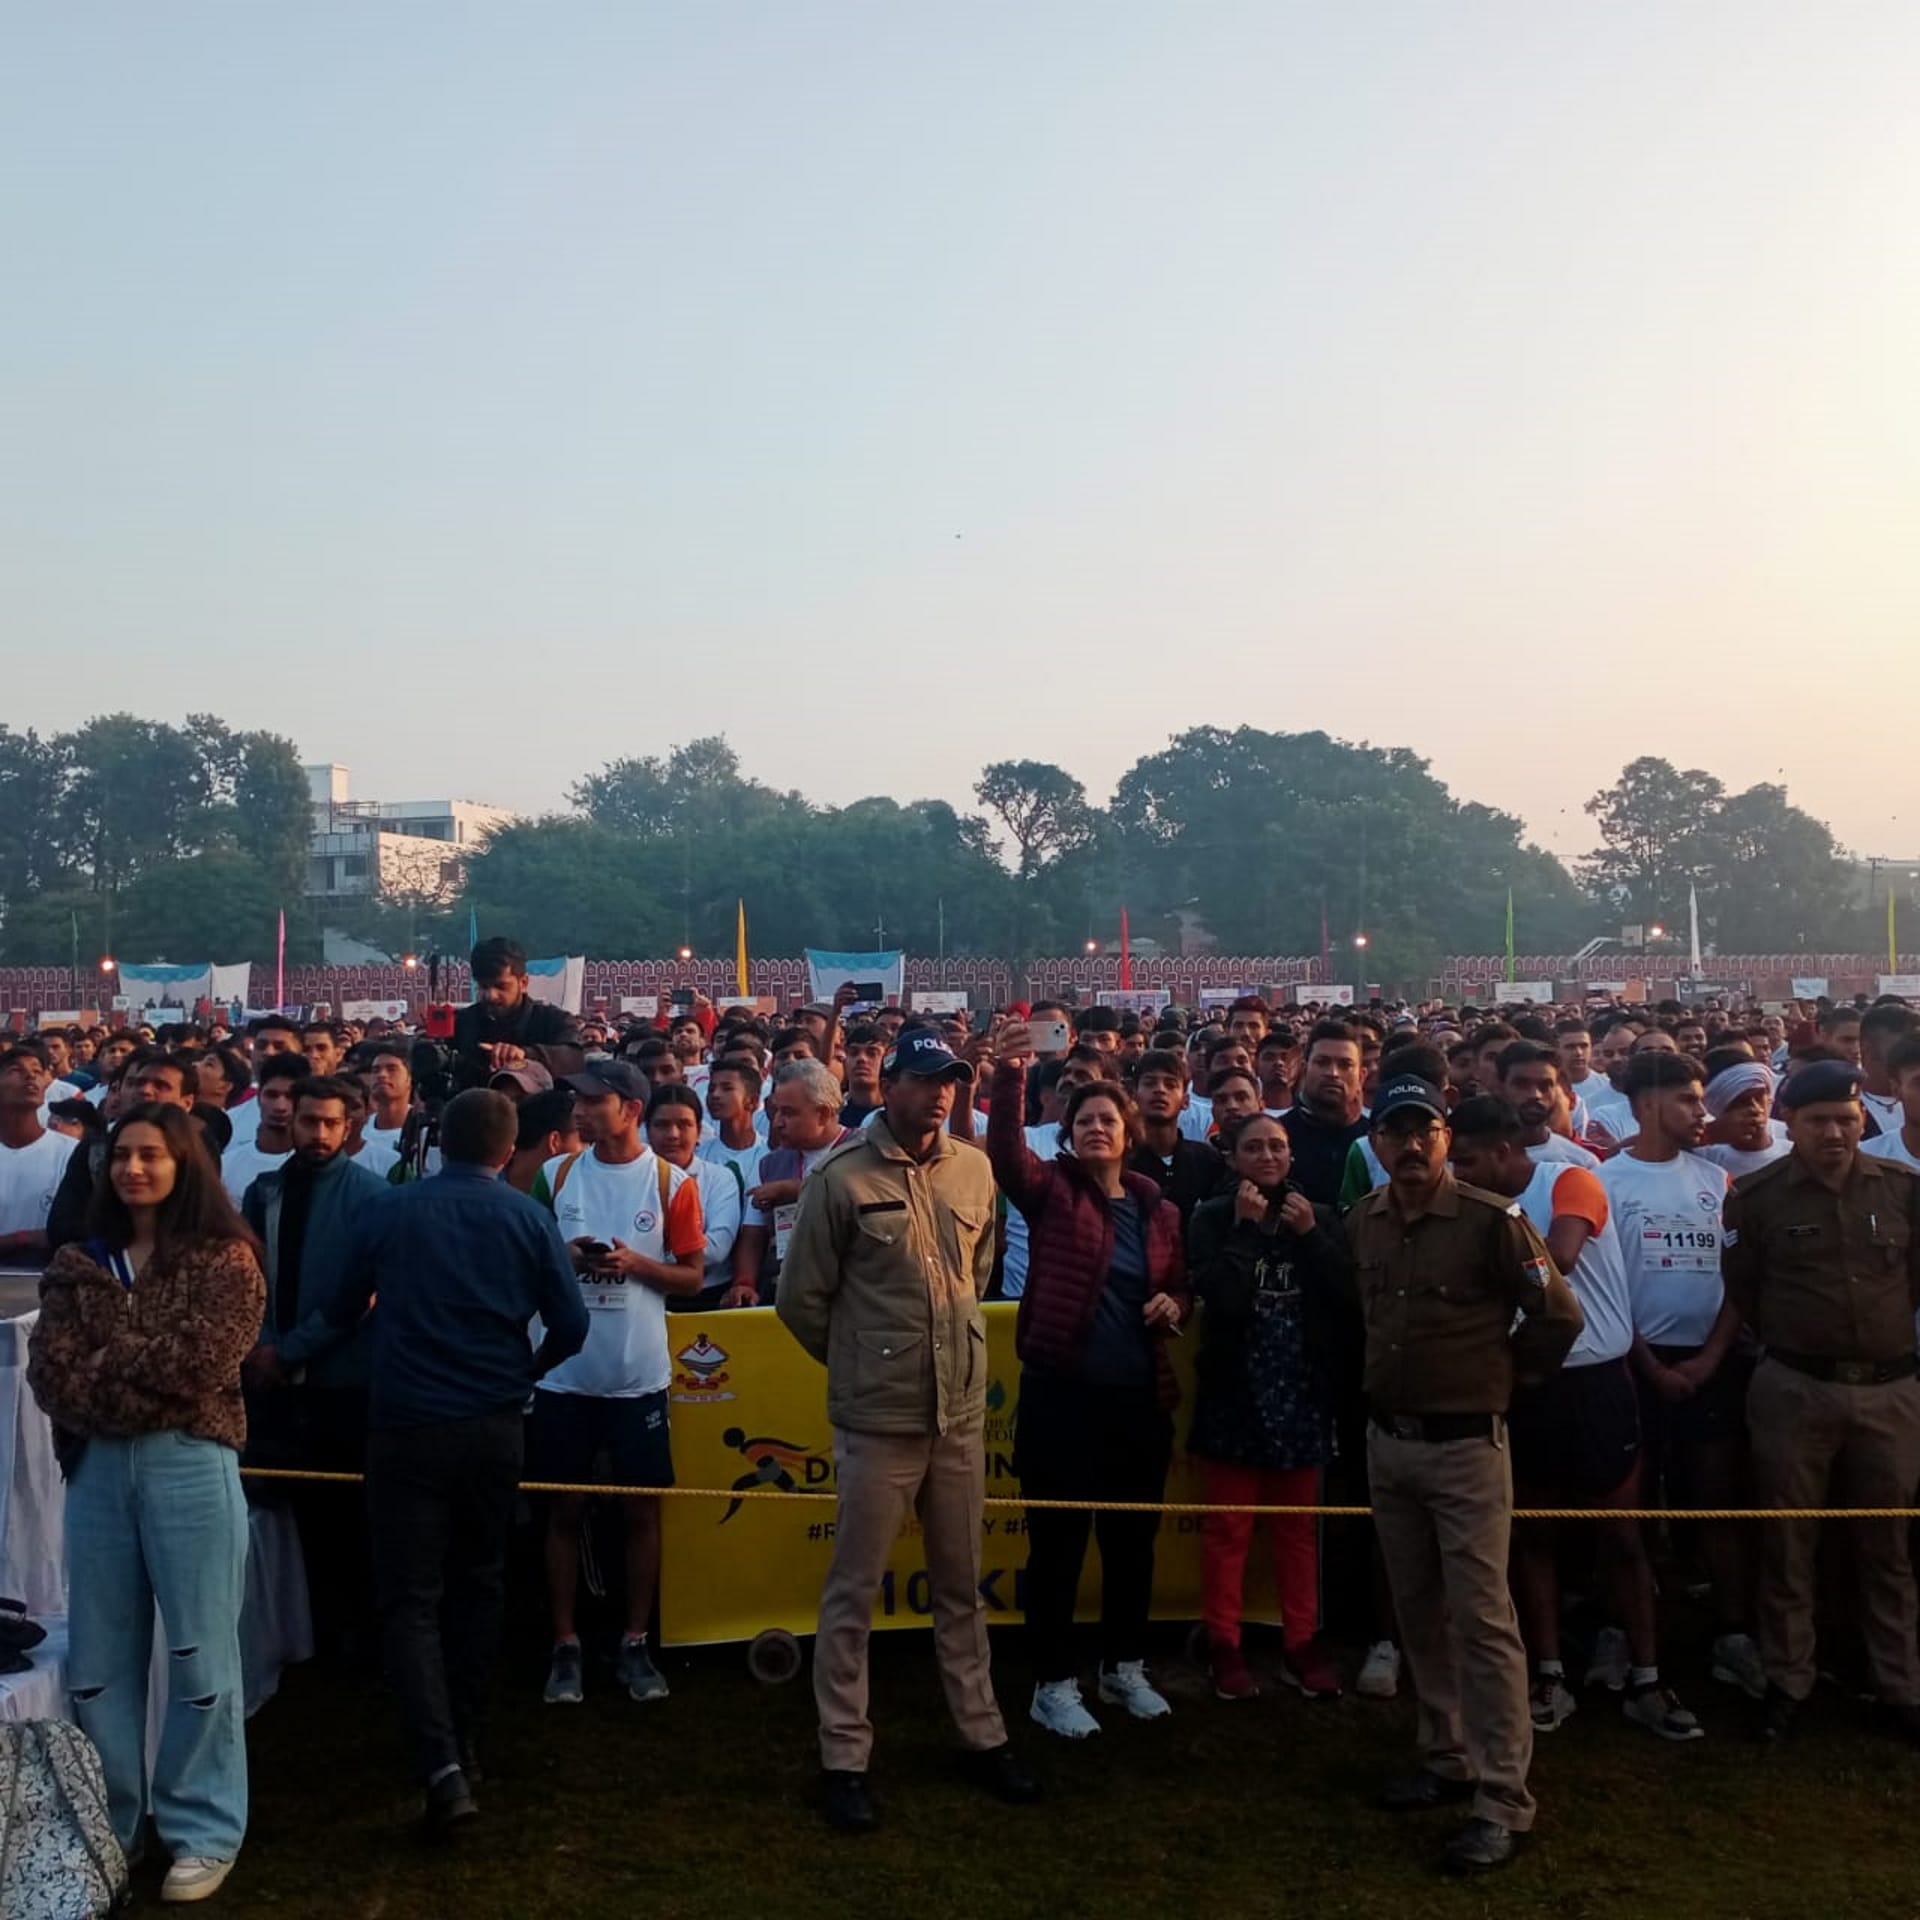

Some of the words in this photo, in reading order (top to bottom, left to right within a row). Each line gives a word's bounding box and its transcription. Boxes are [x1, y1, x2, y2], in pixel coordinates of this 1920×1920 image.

[1387, 1083, 1427, 1099] POLICE
[1663, 1231, 1716, 1249] 11199
[882, 1569, 933, 1616] 10
